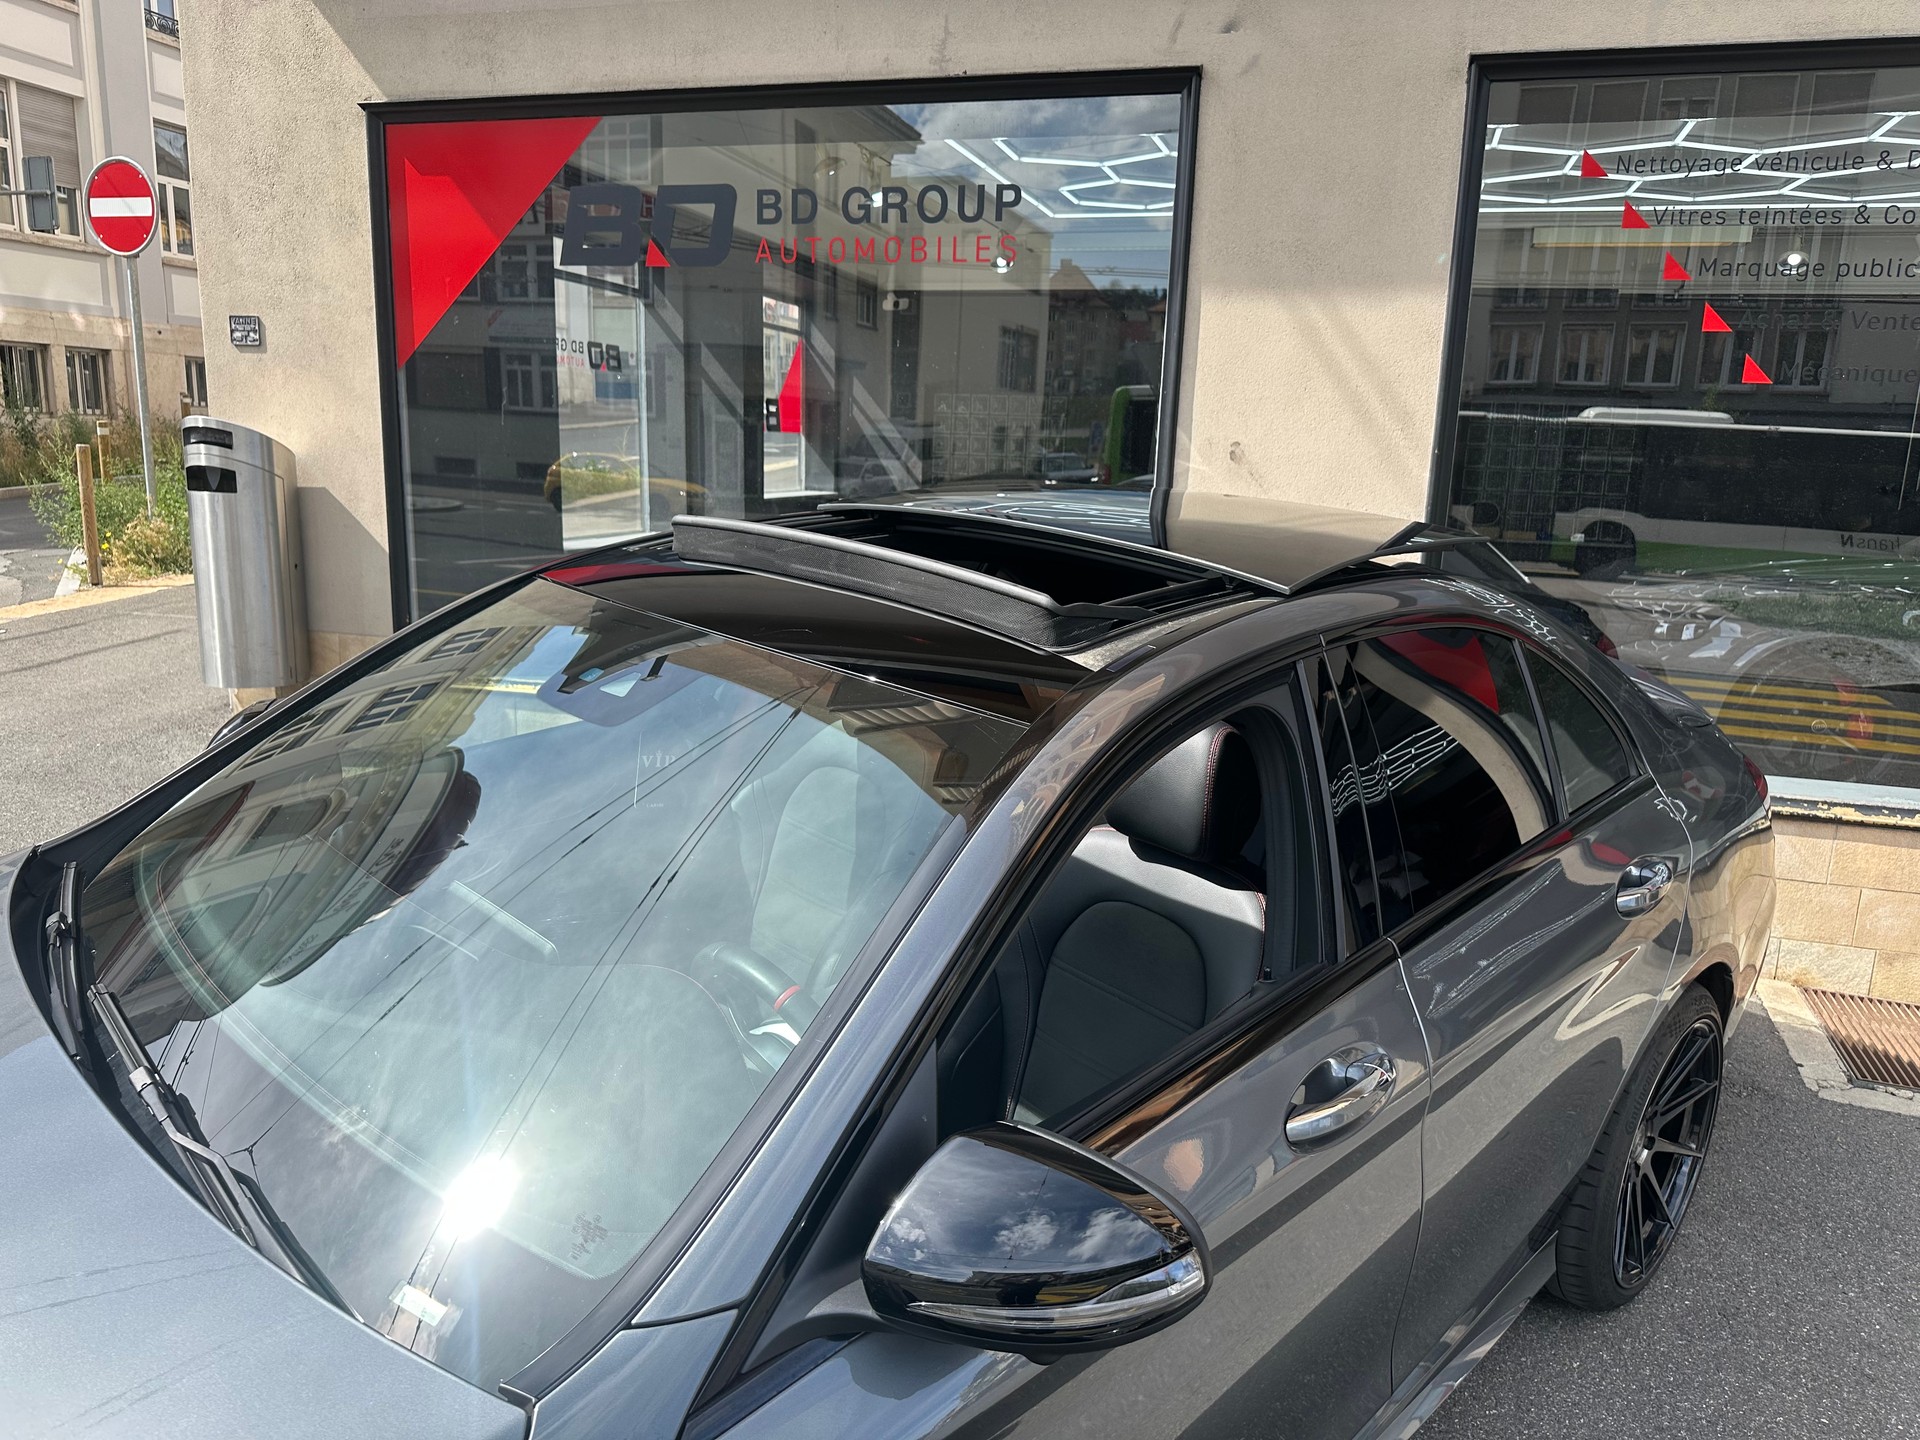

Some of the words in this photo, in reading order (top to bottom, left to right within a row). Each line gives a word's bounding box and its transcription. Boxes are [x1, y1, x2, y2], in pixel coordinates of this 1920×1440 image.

[1616, 154, 1743, 178] Nettoyage
[1755, 151, 1865, 171] véhicule
[1876, 150, 1894, 170] &
[756, 188, 818, 225] BD
[841, 184, 1022, 225] GROUP
[1653, 205, 1727, 225] Vitres
[1738, 203, 1842, 225] teintées
[1854, 204, 1871, 224] &
[754, 234, 1018, 264] AUTOMOBILES
[1698, 257, 1825, 281] Marquage
[1836, 257, 1917, 282] public
[1738, 308, 1812, 330] Achat
[1779, 360, 1918, 388] Mécanique
